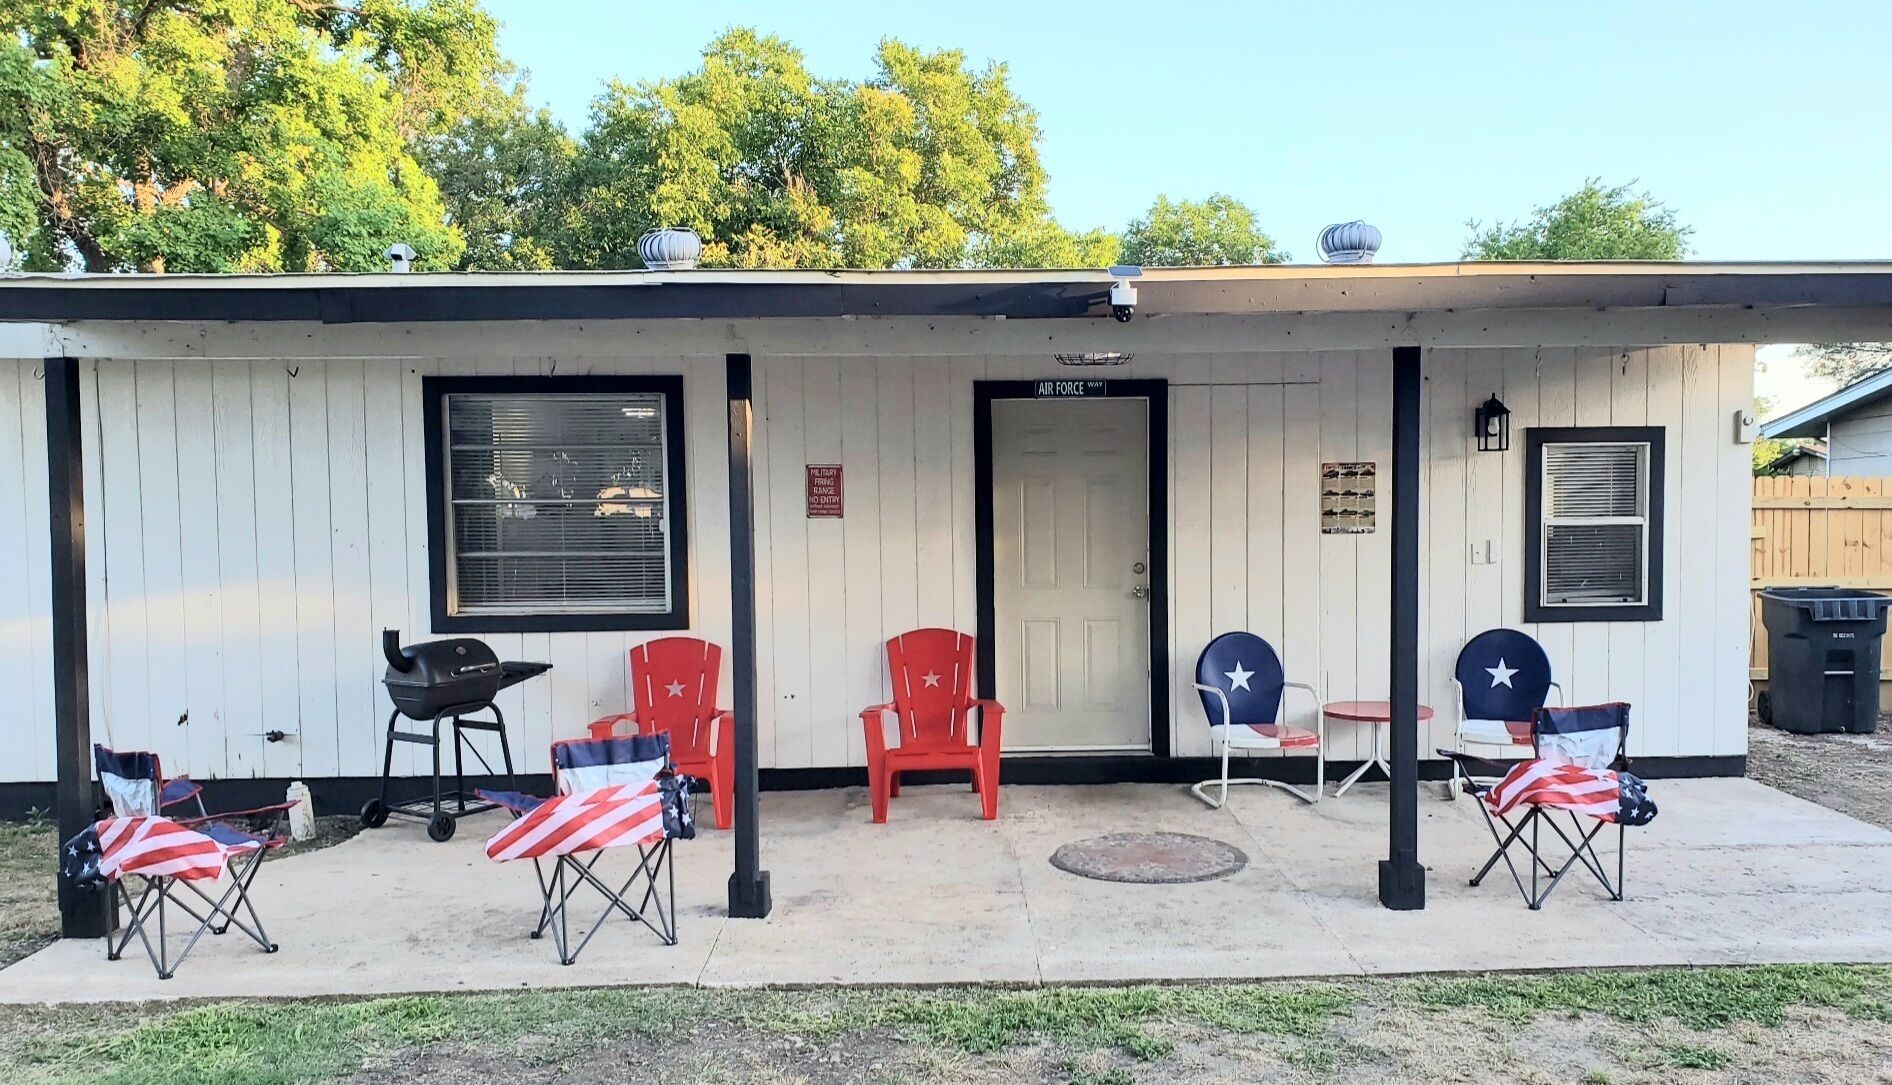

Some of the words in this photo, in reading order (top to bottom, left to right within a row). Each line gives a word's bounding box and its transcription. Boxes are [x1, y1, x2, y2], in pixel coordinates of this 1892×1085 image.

[1038, 381, 1054, 395] AIR
[1056, 381, 1084, 395] FORCE
[810, 468, 837, 476] MILITARY
[814, 477, 834, 486] FIRING
[813, 486, 835, 495] RANGE
[808, 495, 819, 504] NO
[820, 495, 840, 504] ENTRY
